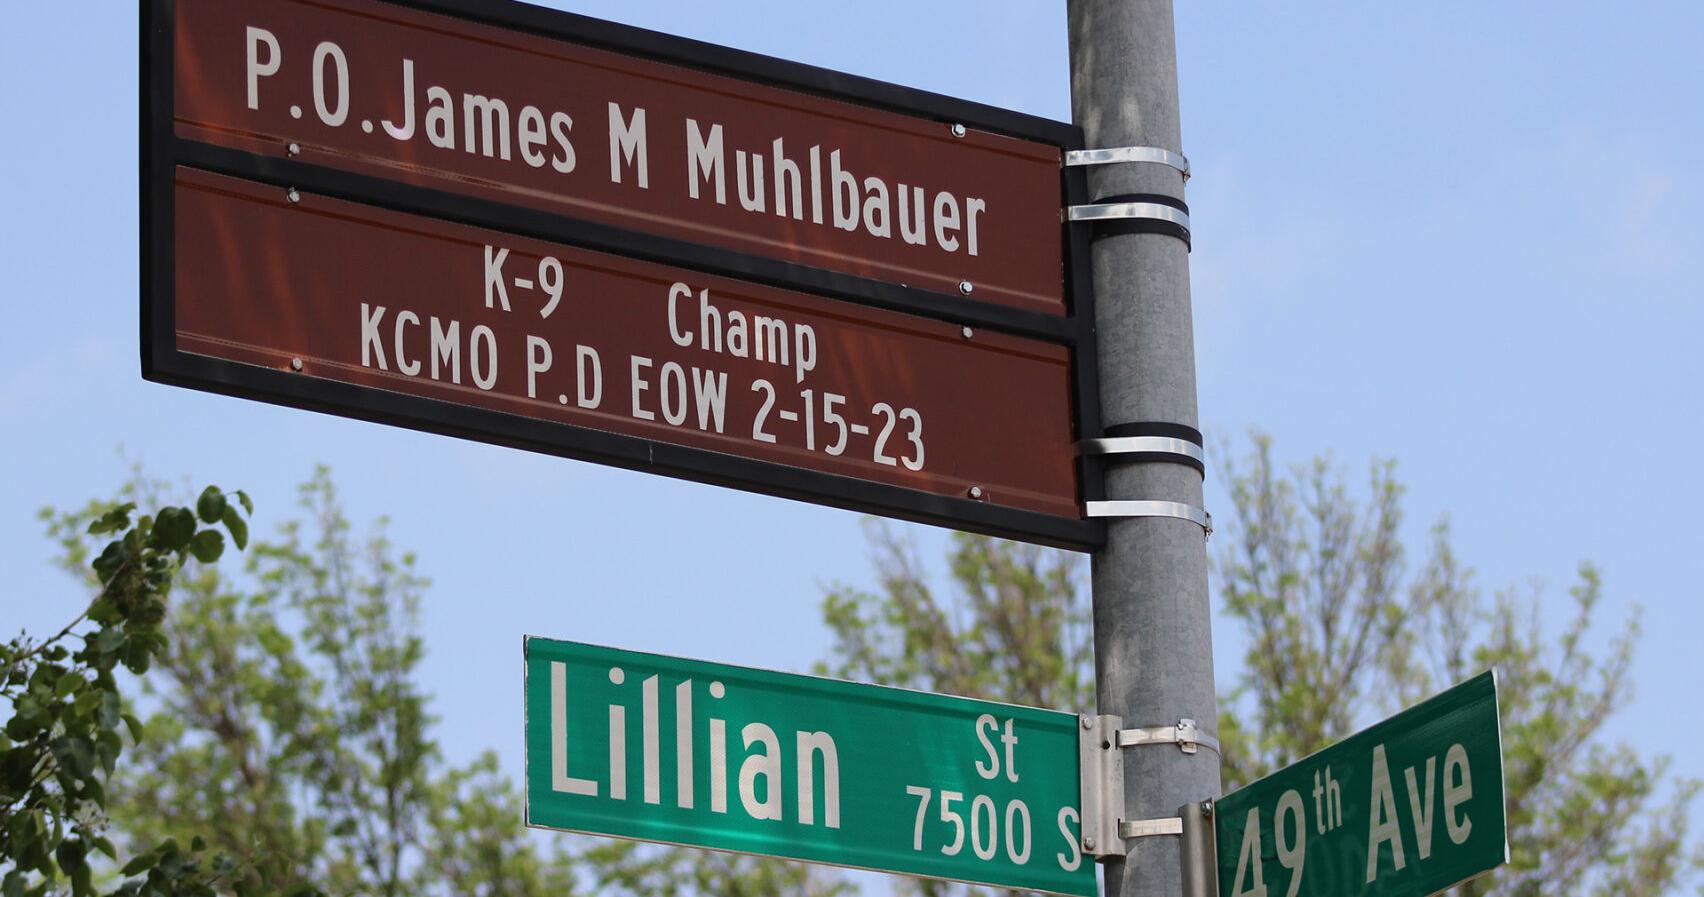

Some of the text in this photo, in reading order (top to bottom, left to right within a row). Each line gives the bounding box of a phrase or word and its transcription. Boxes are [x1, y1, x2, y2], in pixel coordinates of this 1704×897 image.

[609, 102, 648, 188] M
[686, 119, 985, 256] Muhlbauer
[485, 245, 816, 383] K-9 Champ
[361, 303, 924, 471] KCMO P.D EOW 2-15-23
[551, 661, 840, 829] Lillian
[975, 714, 1018, 782] St
[1366, 744, 1473, 884] Ave
[906, 786, 1081, 871] 7500 S
